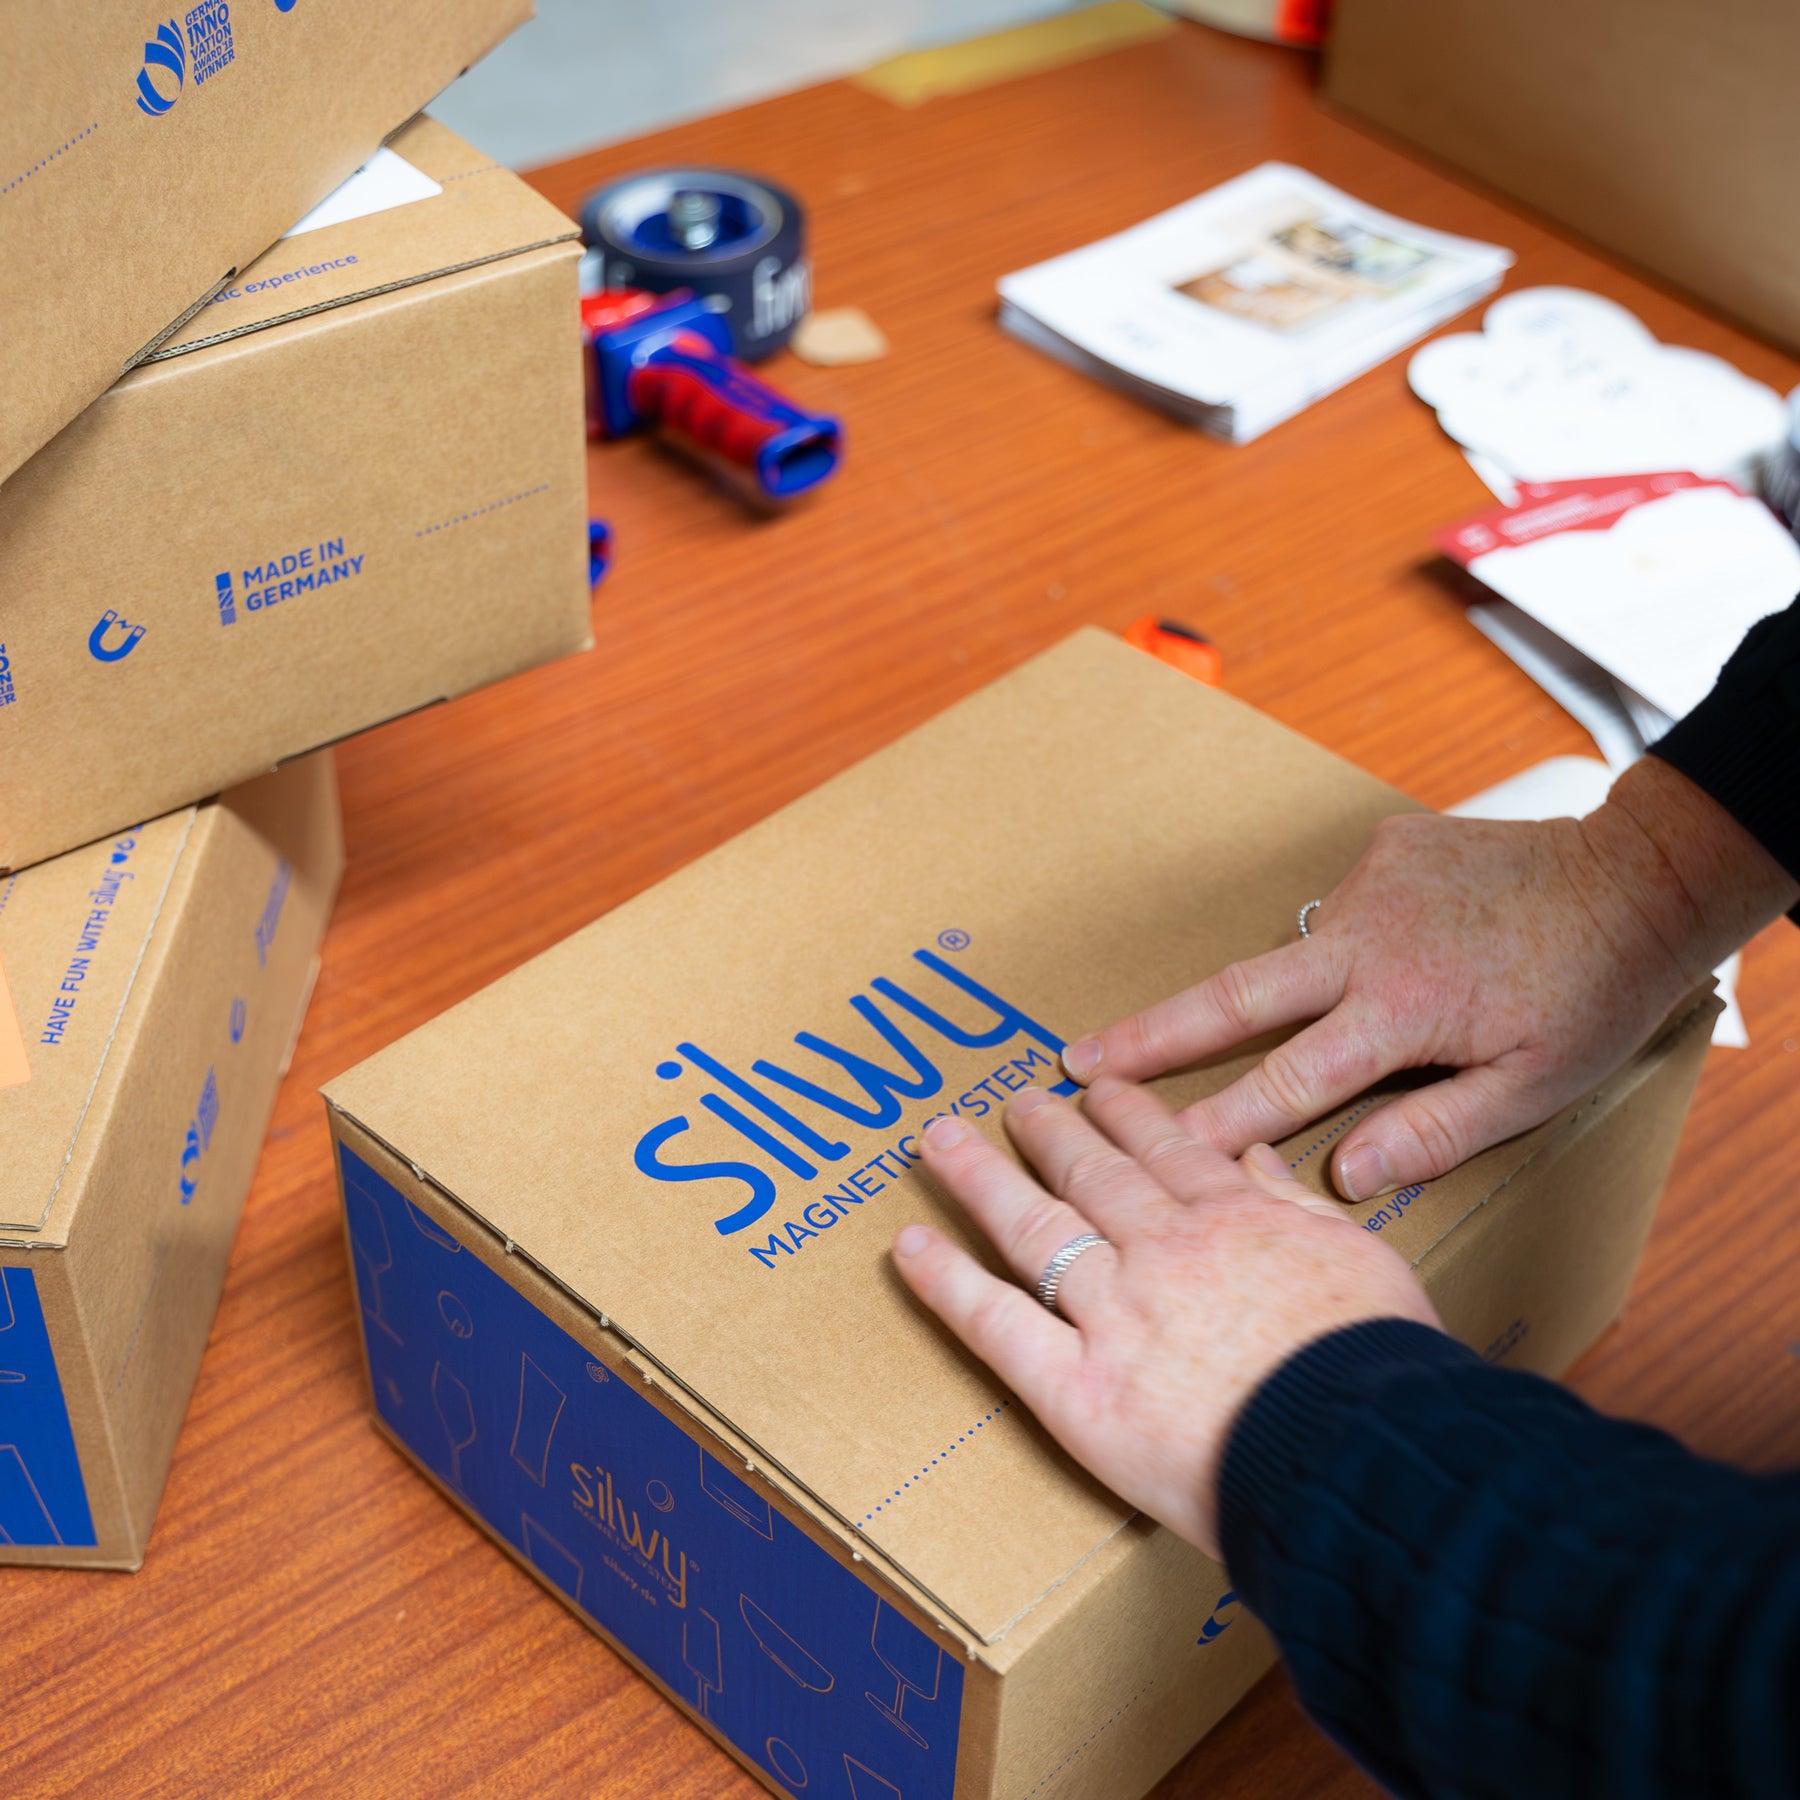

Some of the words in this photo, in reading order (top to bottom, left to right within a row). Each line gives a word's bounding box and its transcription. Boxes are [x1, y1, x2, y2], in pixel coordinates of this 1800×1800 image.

[187, 3, 229, 47] INNO
[190, 22, 231, 60] VATION
[193, 46, 222, 74] AWARD
[194, 49, 235, 86] WINNER
[244, 254, 359, 294] experience
[243, 548, 315, 589] MADE
[319, 537, 344, 562] IN
[246, 554, 365, 612] GERMANY
[76, 908, 110, 952] WITH
[61, 957, 92, 992] FUN
[40, 997, 76, 1045] HAVE
[748, 1135, 923, 1269] MAGNETIC
[1361, 1209, 1393, 1234] en
